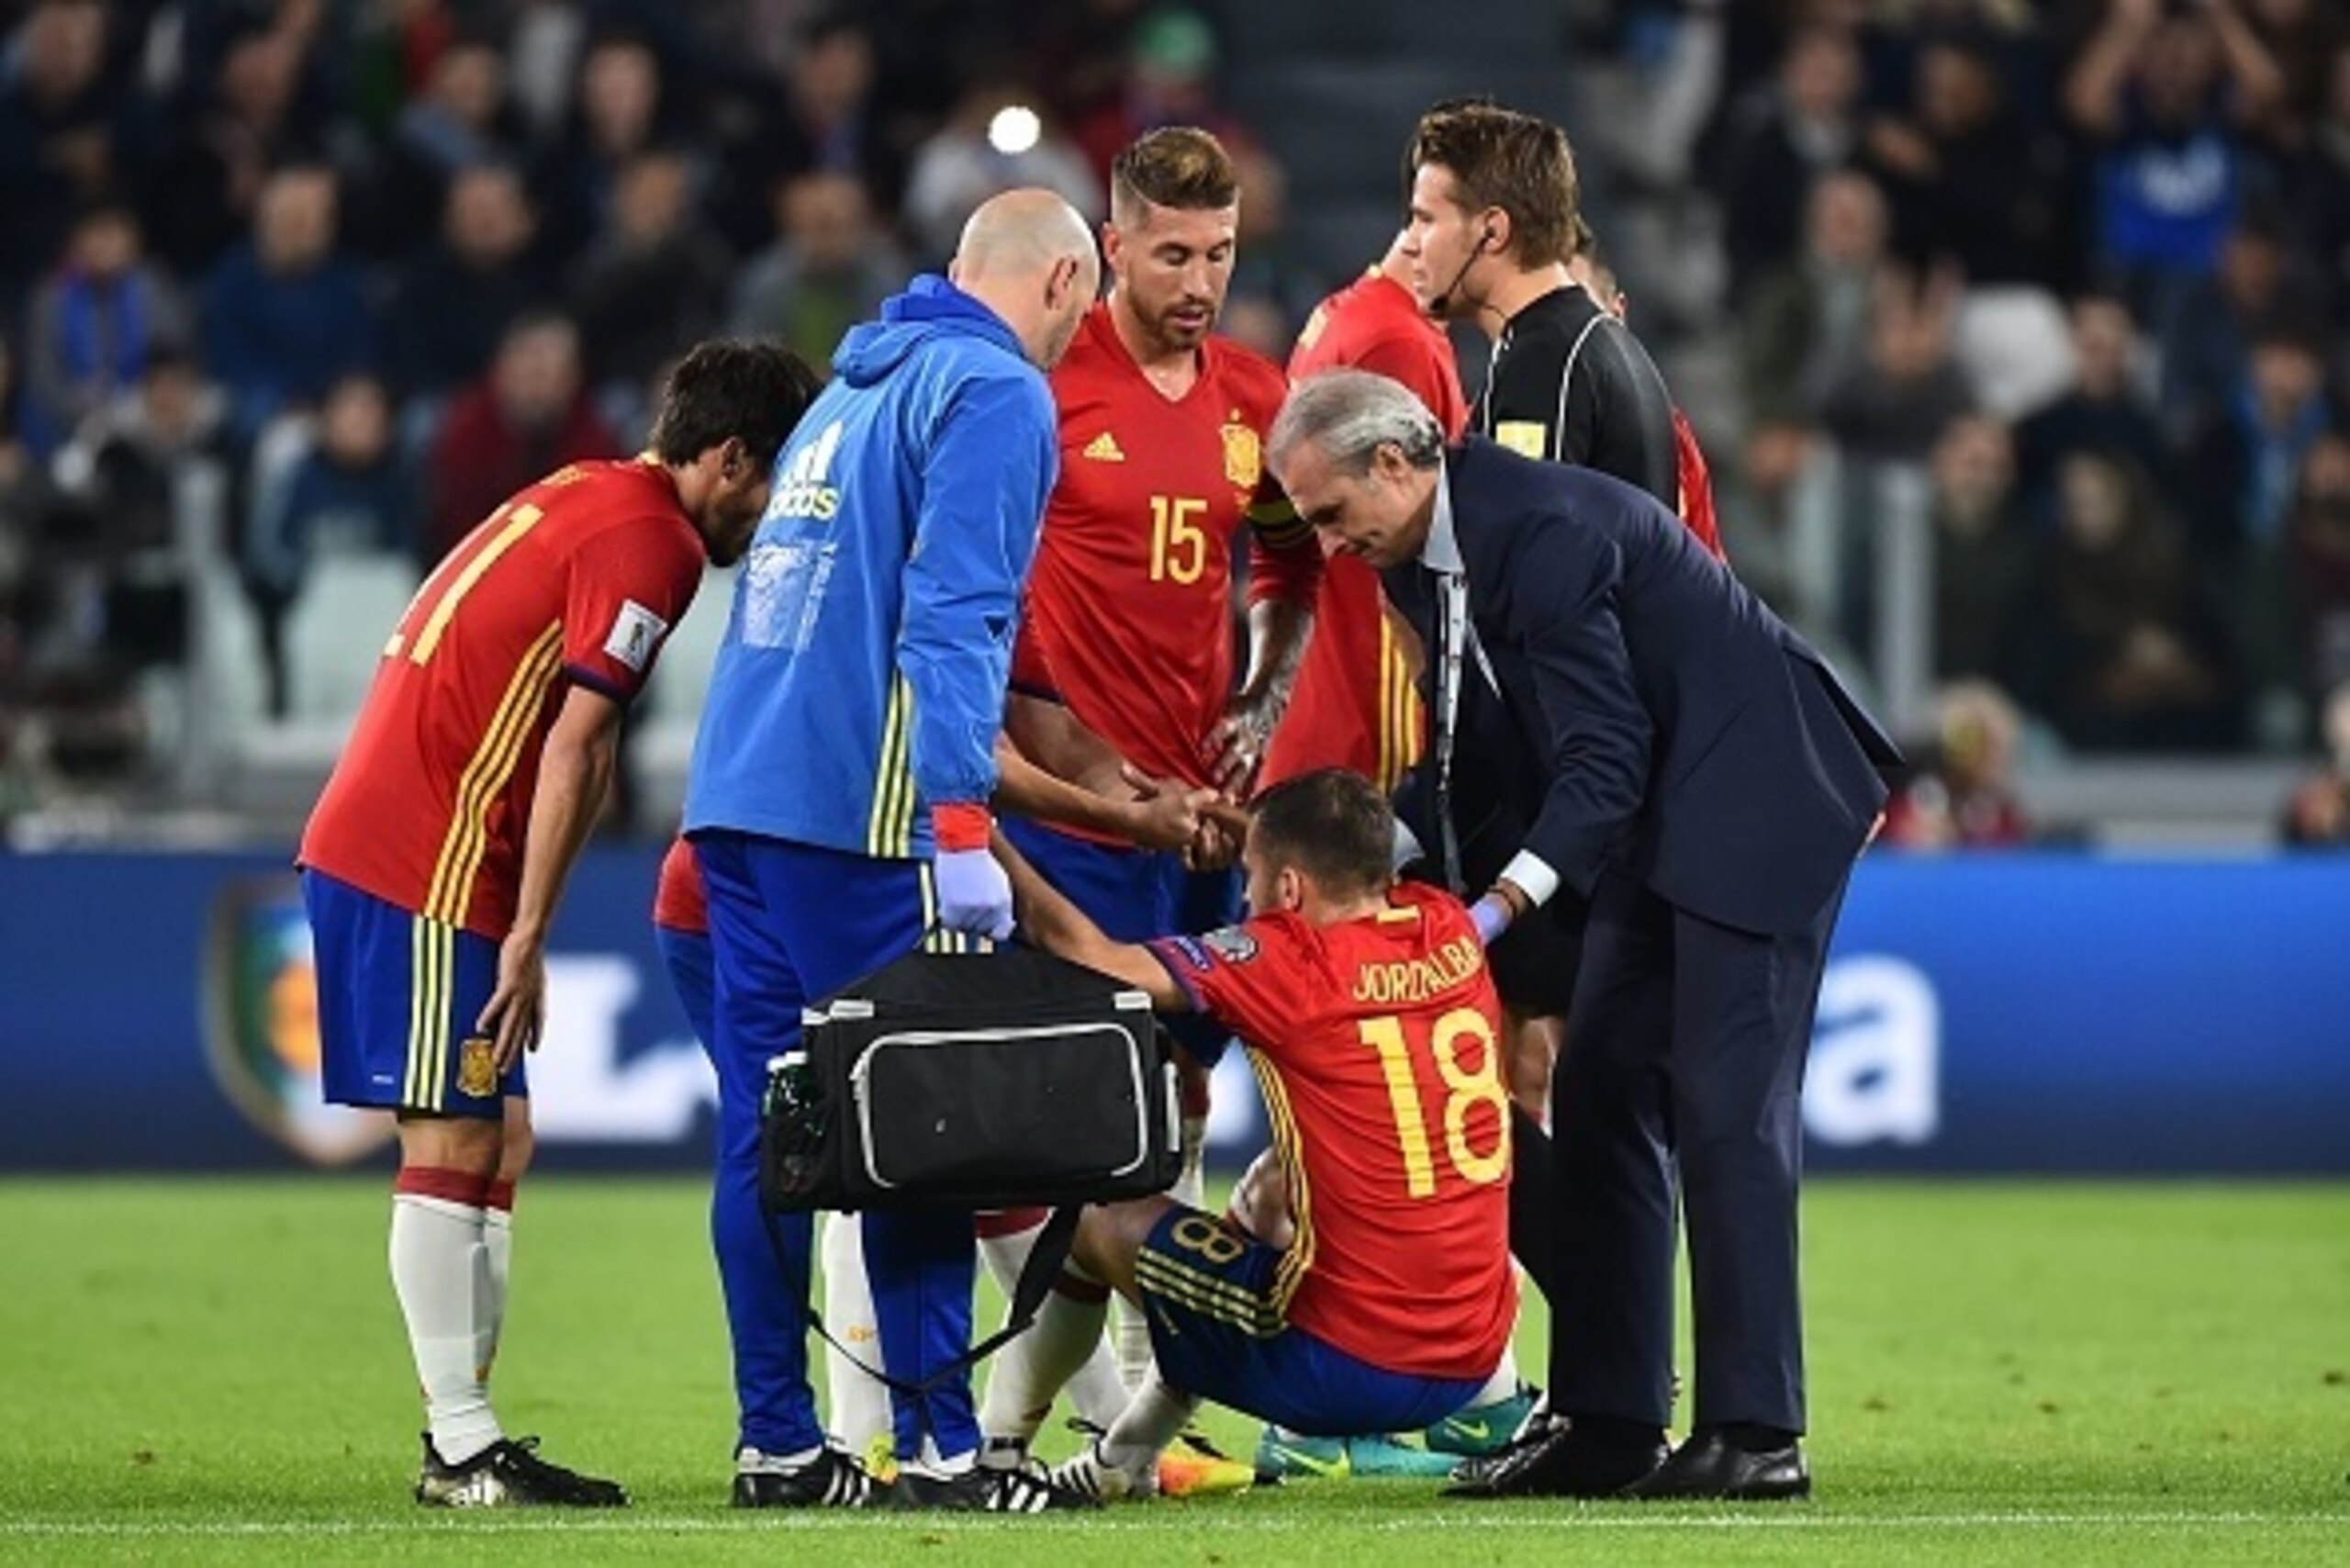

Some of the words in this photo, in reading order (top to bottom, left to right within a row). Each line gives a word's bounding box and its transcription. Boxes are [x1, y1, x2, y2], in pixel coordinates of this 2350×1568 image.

[383, 502, 544, 666] 1
[1150, 496, 1207, 584] 15
[1359, 1008, 1512, 1197] 18
[1171, 1214, 1244, 1263] 8
